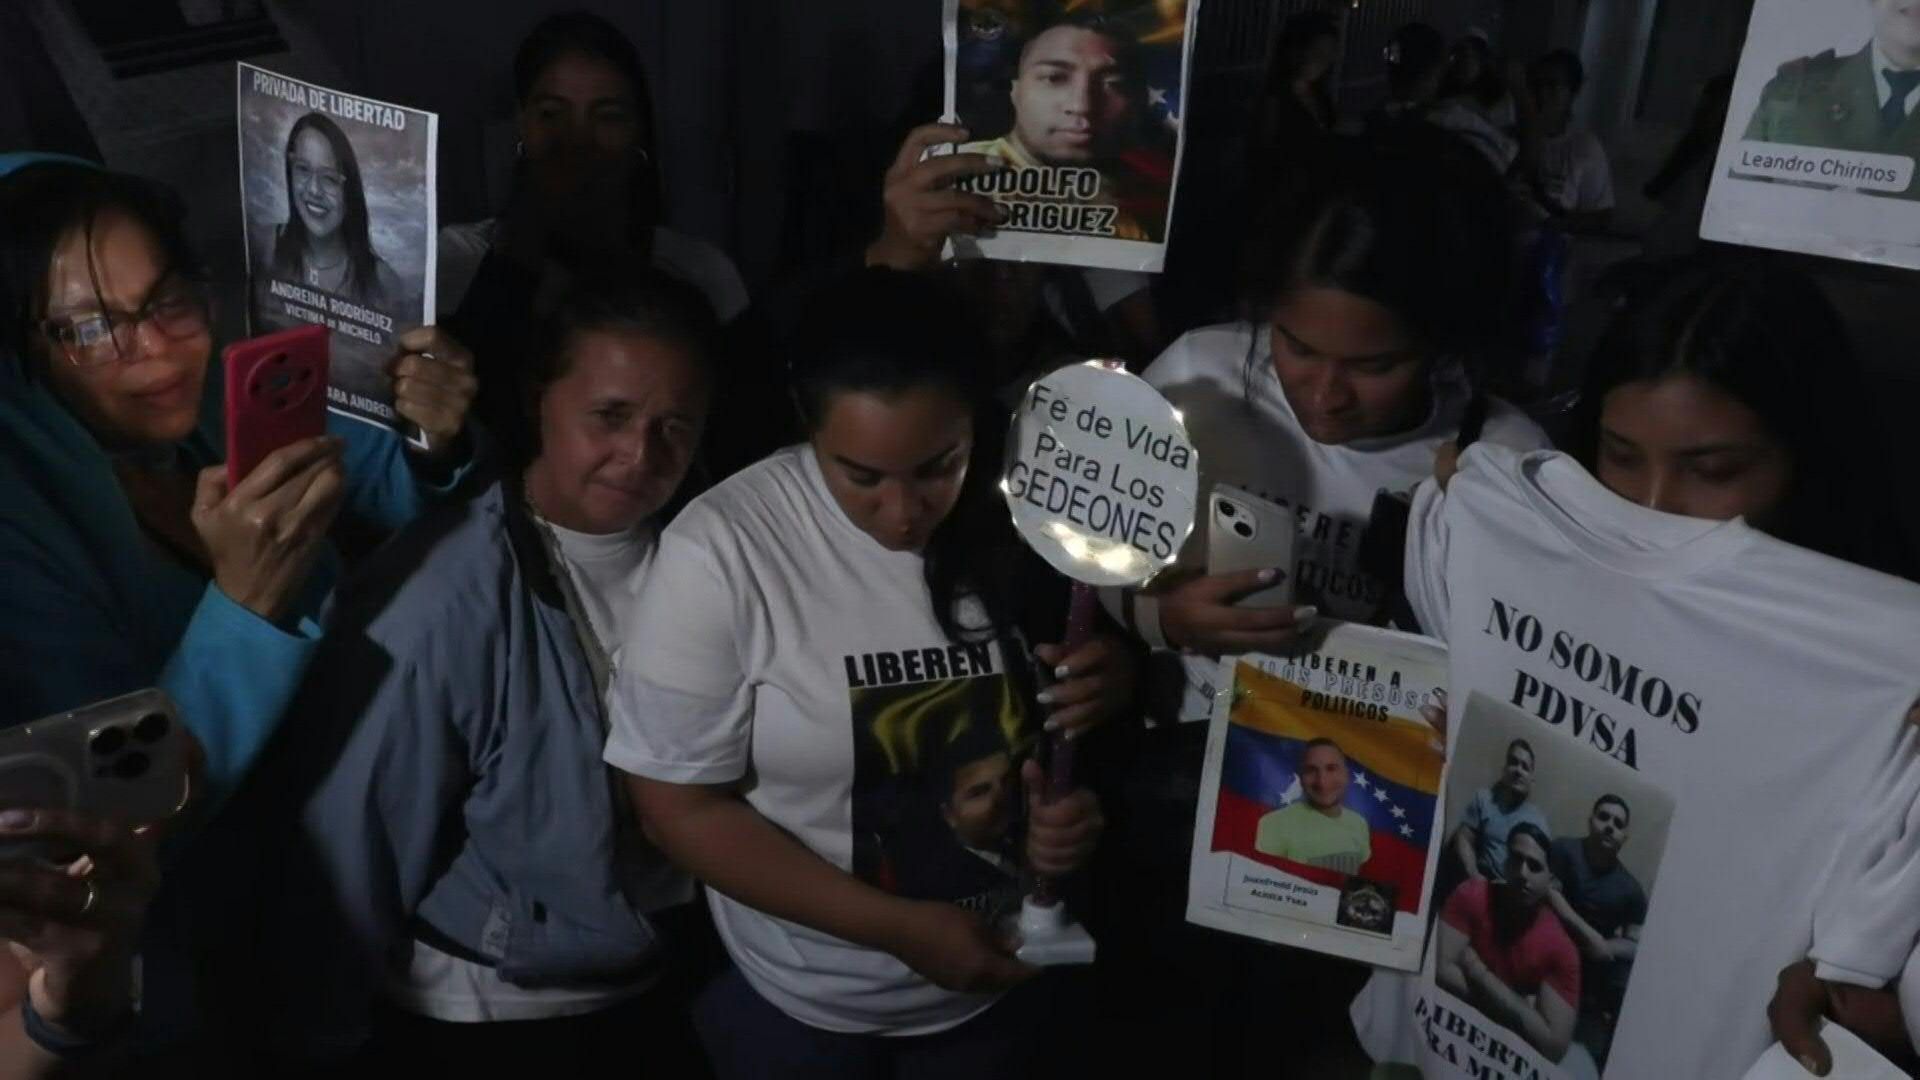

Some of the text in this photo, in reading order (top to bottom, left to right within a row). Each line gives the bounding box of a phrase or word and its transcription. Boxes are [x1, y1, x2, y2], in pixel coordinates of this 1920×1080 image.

[253, 70, 406, 131] PRIVADA DE LIBERTAD
[1741, 151, 1897, 183] Leandro Chirinos
[270, 279, 328, 310] ANDREINA
[1076, 405, 1113, 438] de
[1033, 432, 1164, 508] Para Los
[1008, 461, 1175, 560] GEDEONES
[844, 640, 993, 688] LIBEREN
[1390, 671, 1402, 687] A
[1482, 597, 1702, 734] NO SOMOS
[1300, 689, 1390, 722] POLITICOS
[1510, 668, 1640, 771] PDVSA
